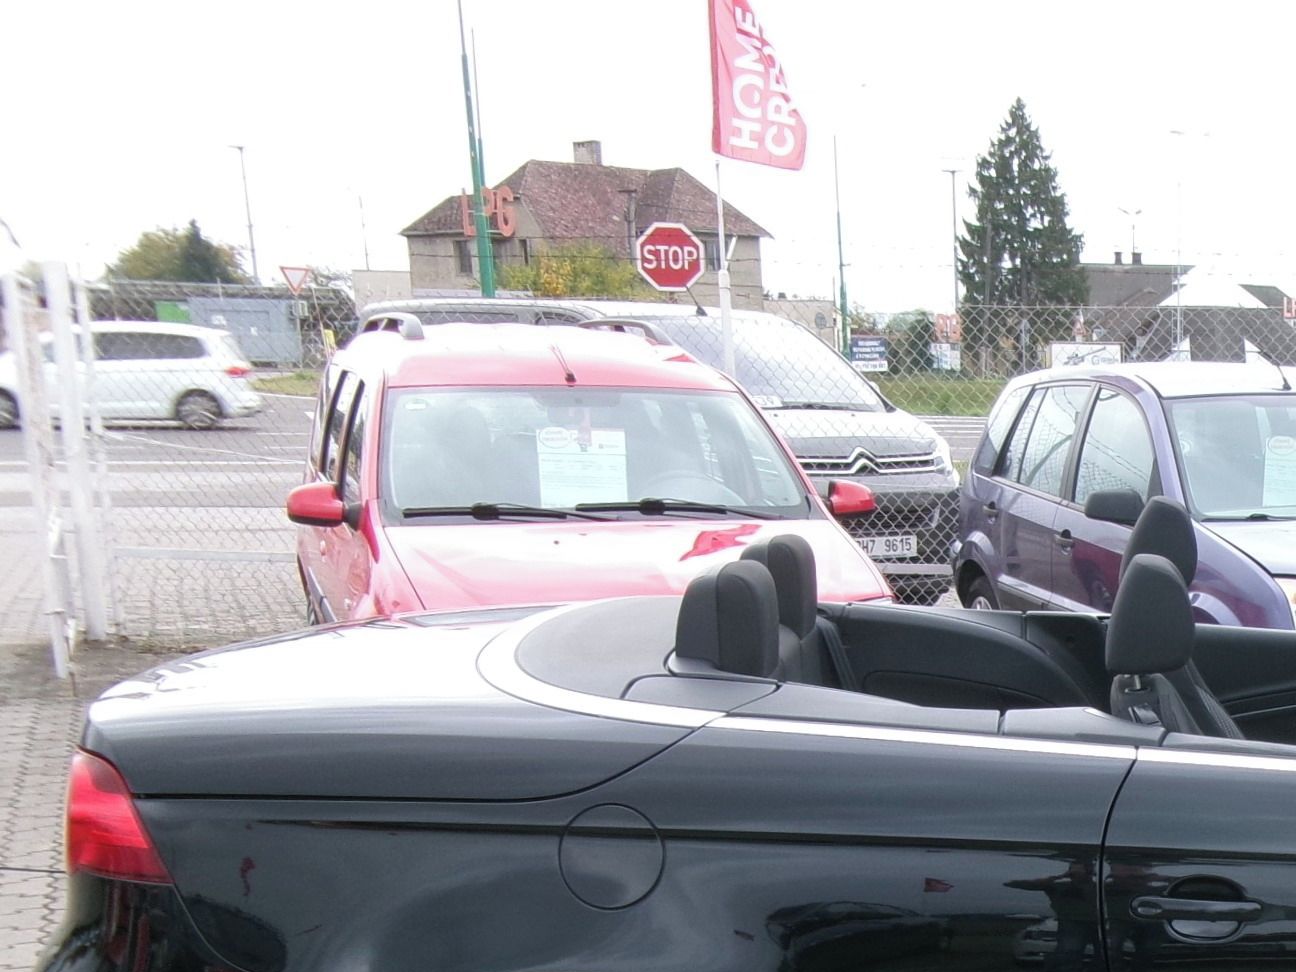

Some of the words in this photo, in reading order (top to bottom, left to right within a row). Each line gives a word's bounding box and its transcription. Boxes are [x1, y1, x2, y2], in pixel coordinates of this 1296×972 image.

[728, 6, 766, 150] HOME
[642, 244, 698, 271] STOP
[884, 538, 912, 553] 9615
